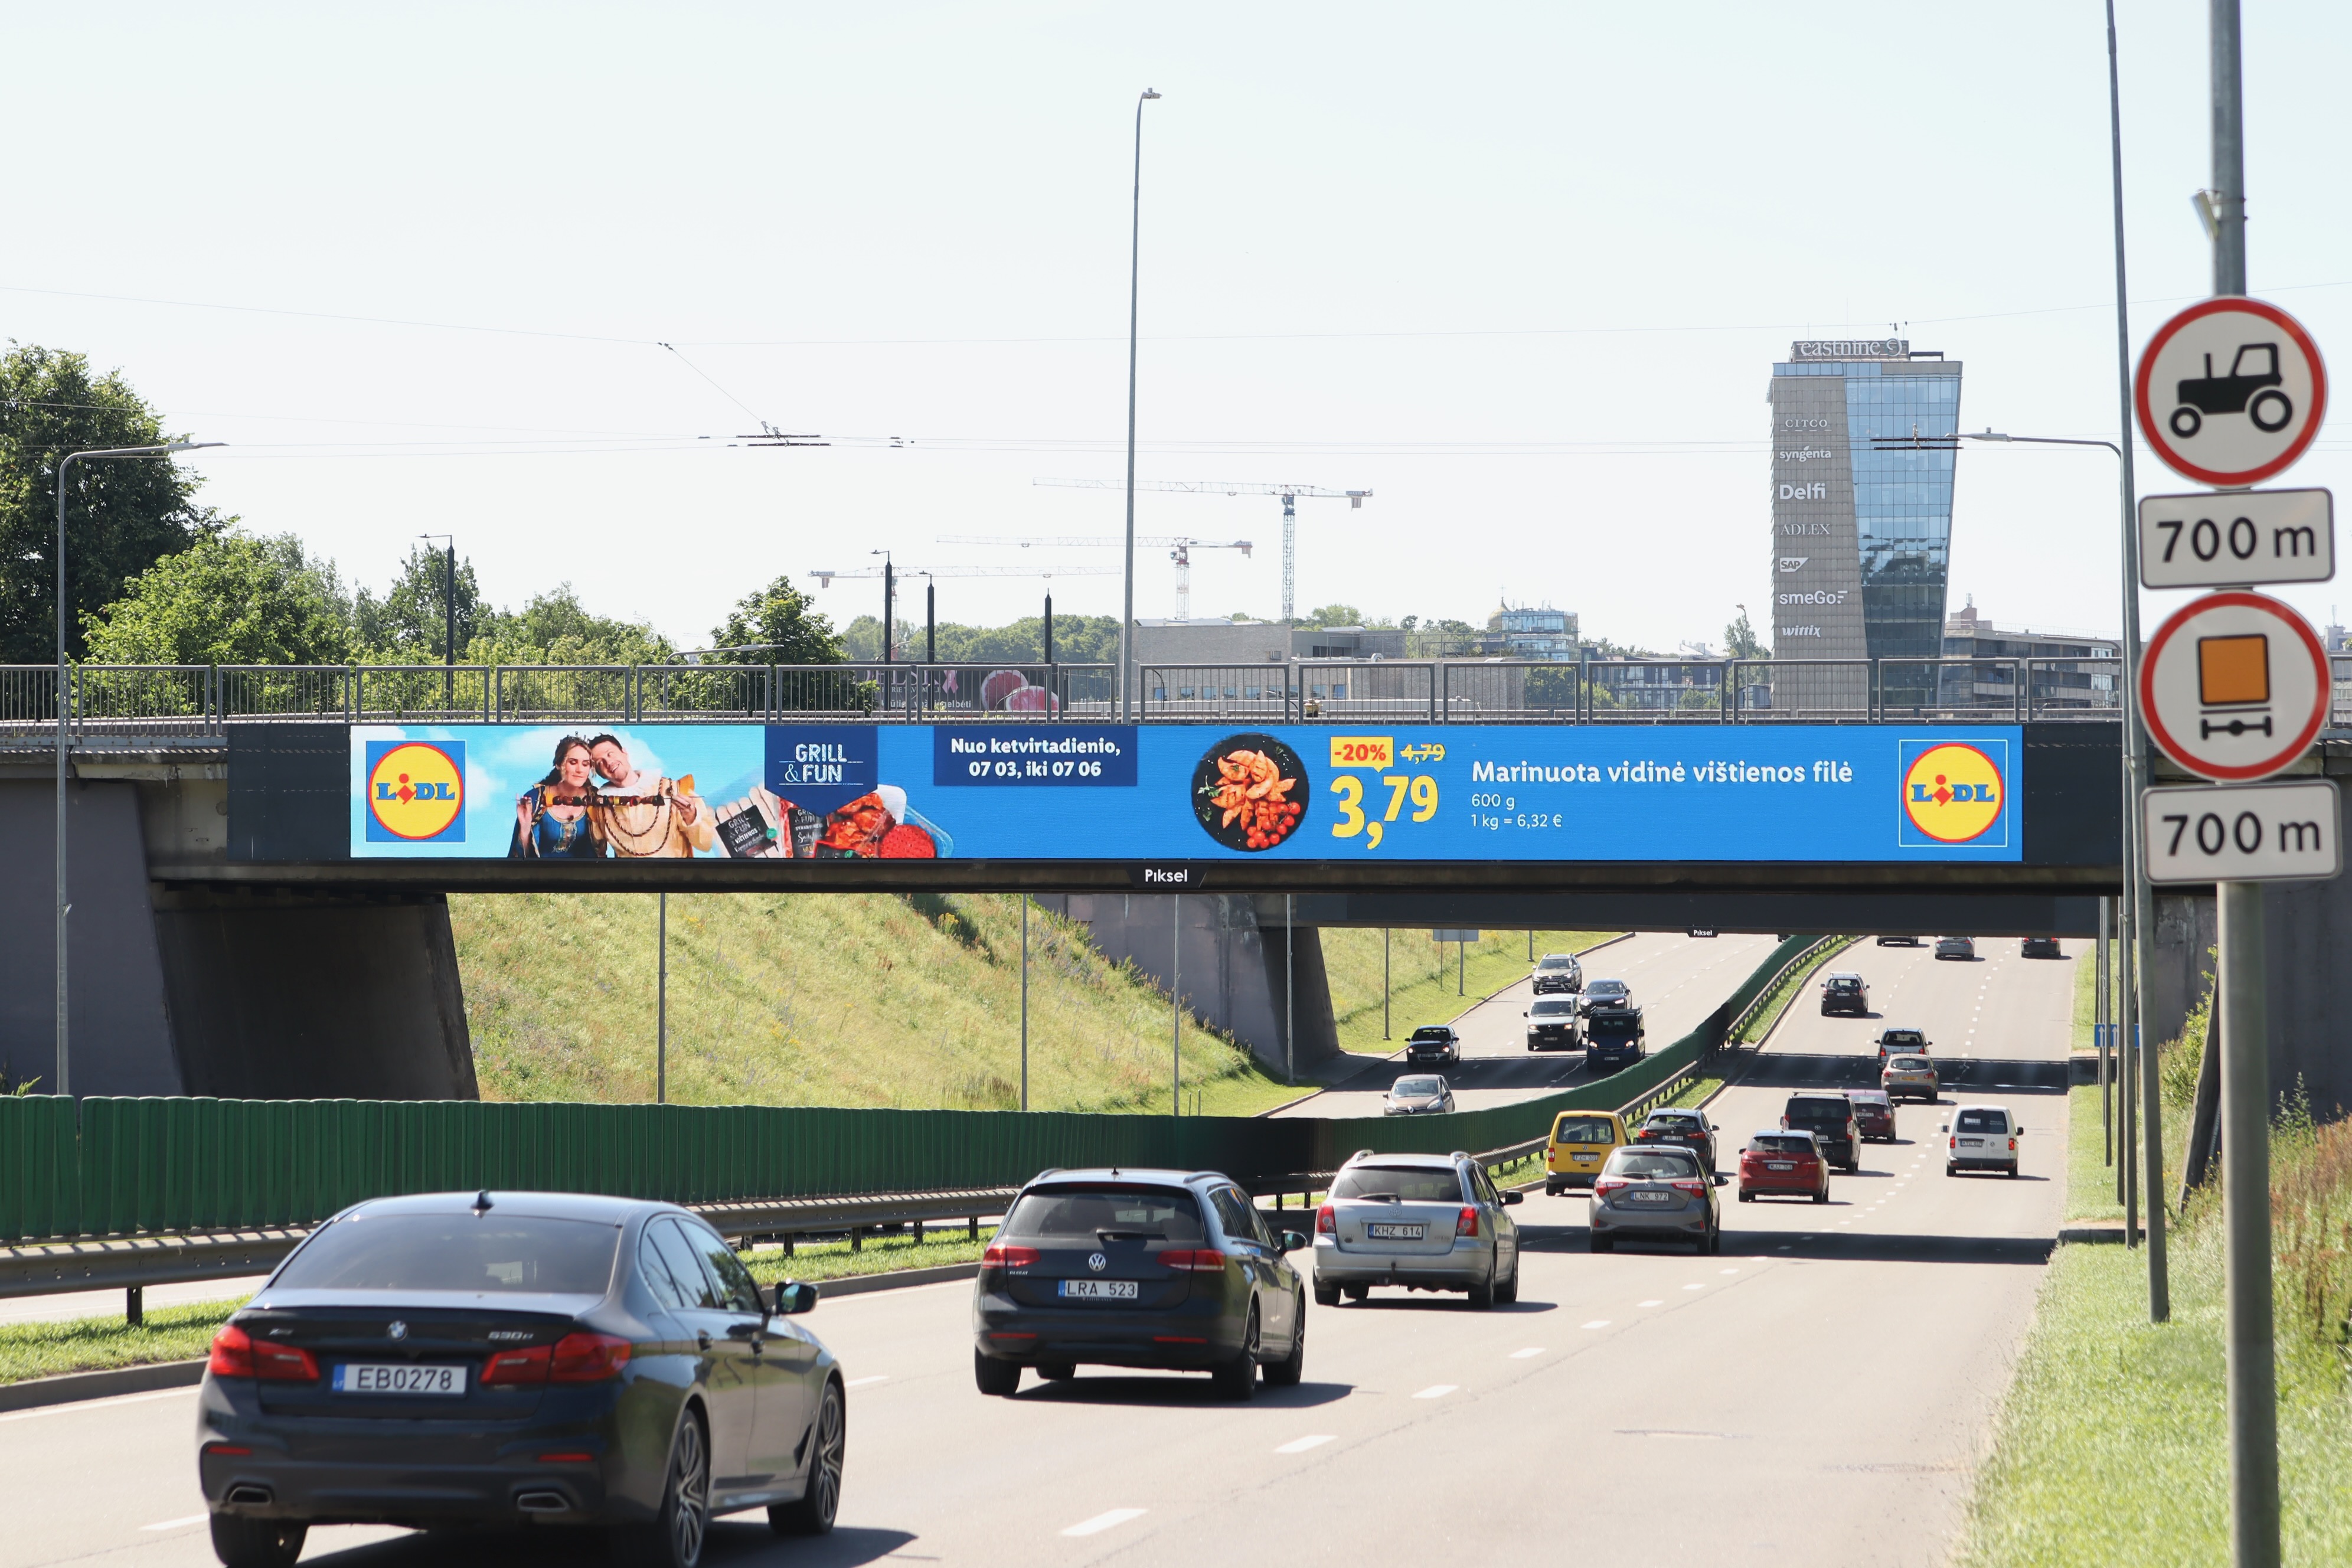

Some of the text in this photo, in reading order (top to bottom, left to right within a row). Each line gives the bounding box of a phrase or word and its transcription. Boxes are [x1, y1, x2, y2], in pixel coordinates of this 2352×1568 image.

[1801, 339, 1881, 356] eastnine
[1785, 419, 1828, 427] CITCO
[1779, 447, 1831, 462] syngenta
[1779, 482, 1826, 500] Delfi
[1780, 524, 1830, 535] ADLEX
[2157, 517, 2315, 563] 700 m
[1781, 560, 1801, 570] SAP
[1782, 625, 1821, 638] wittix
[796, 743, 848, 763] GRILL
[951, 737, 1121, 756] Nuo ketvirtadienio,
[1334, 743, 1446, 765] -20% 4,79
[802, 764, 842, 783] FUN
[969, 760, 1102, 779] 07 03, iki 07 06
[1472, 760, 1853, 782] Marinuota vidinė vištienos filė
[1471, 793, 1515, 811] 600 g
[1329, 774, 1439, 850] 3,79
[1471, 814, 1477, 827] 1
[1482, 814, 1499, 831] kg
[1517, 814, 1549, 829] 6,32
[1552, 814, 1563, 828] €
[2161, 811, 2320, 857] 700 m
[1375, 1227, 1420, 1236] KHZ 614
[1067, 1282, 1136, 1297] LRA 523
[357, 1367, 452, 1390] EB0278
